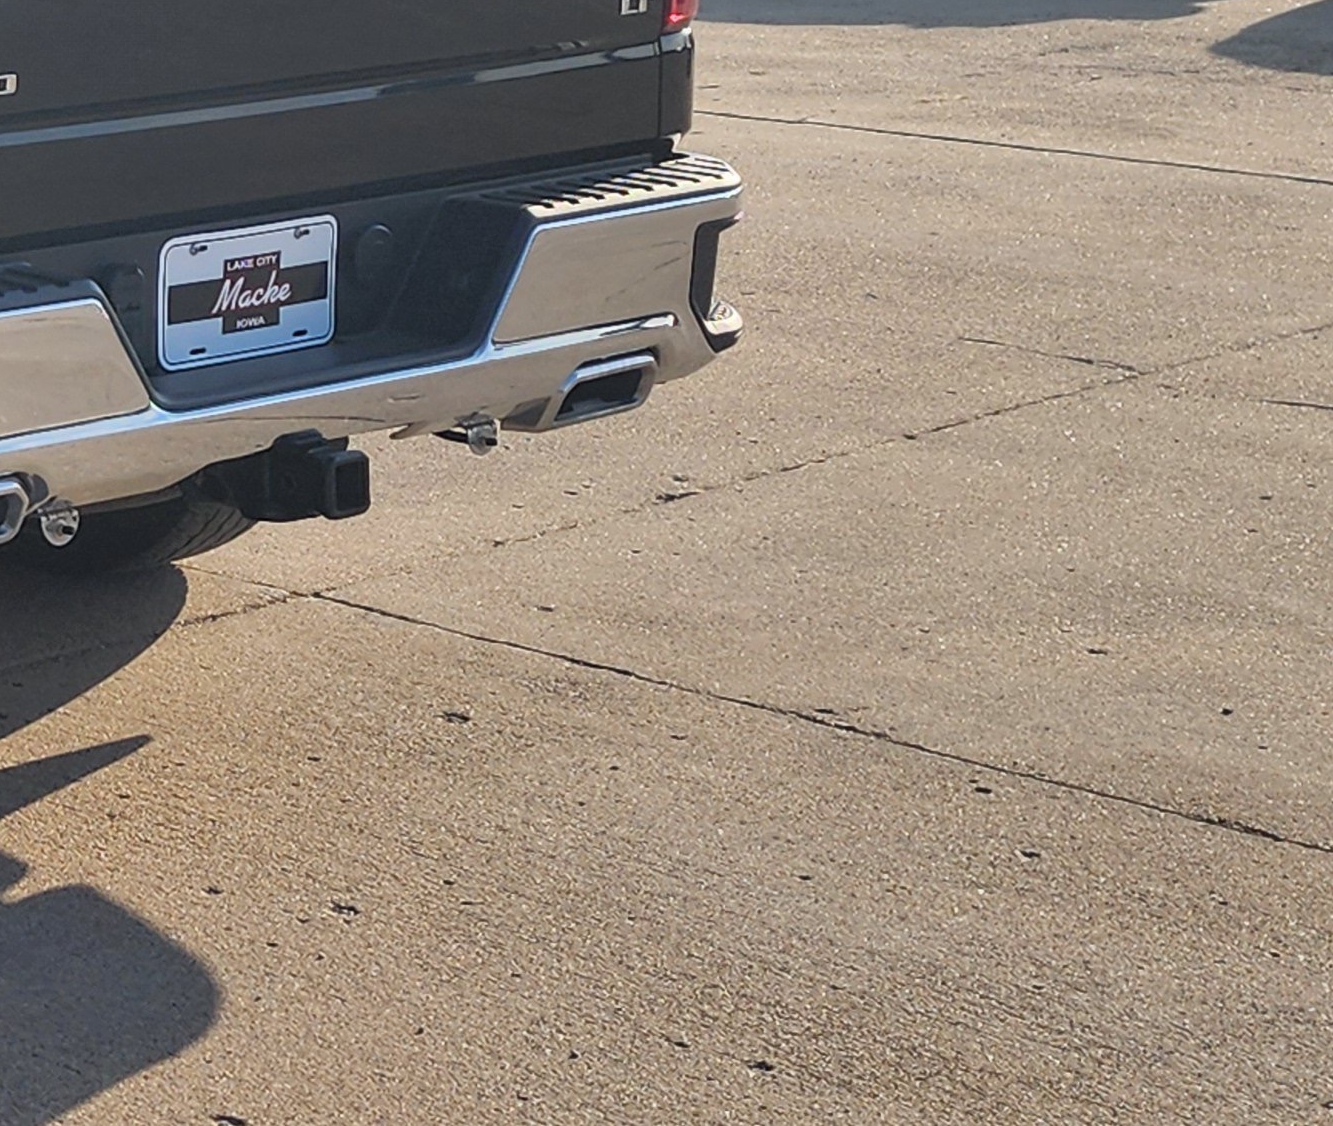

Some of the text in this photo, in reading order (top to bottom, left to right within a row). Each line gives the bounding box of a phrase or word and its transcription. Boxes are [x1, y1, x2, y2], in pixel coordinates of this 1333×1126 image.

[227, 255, 277, 271] LAKE CITY
[211, 269, 292, 314] Macke
[236, 316, 265, 329] IOWA
